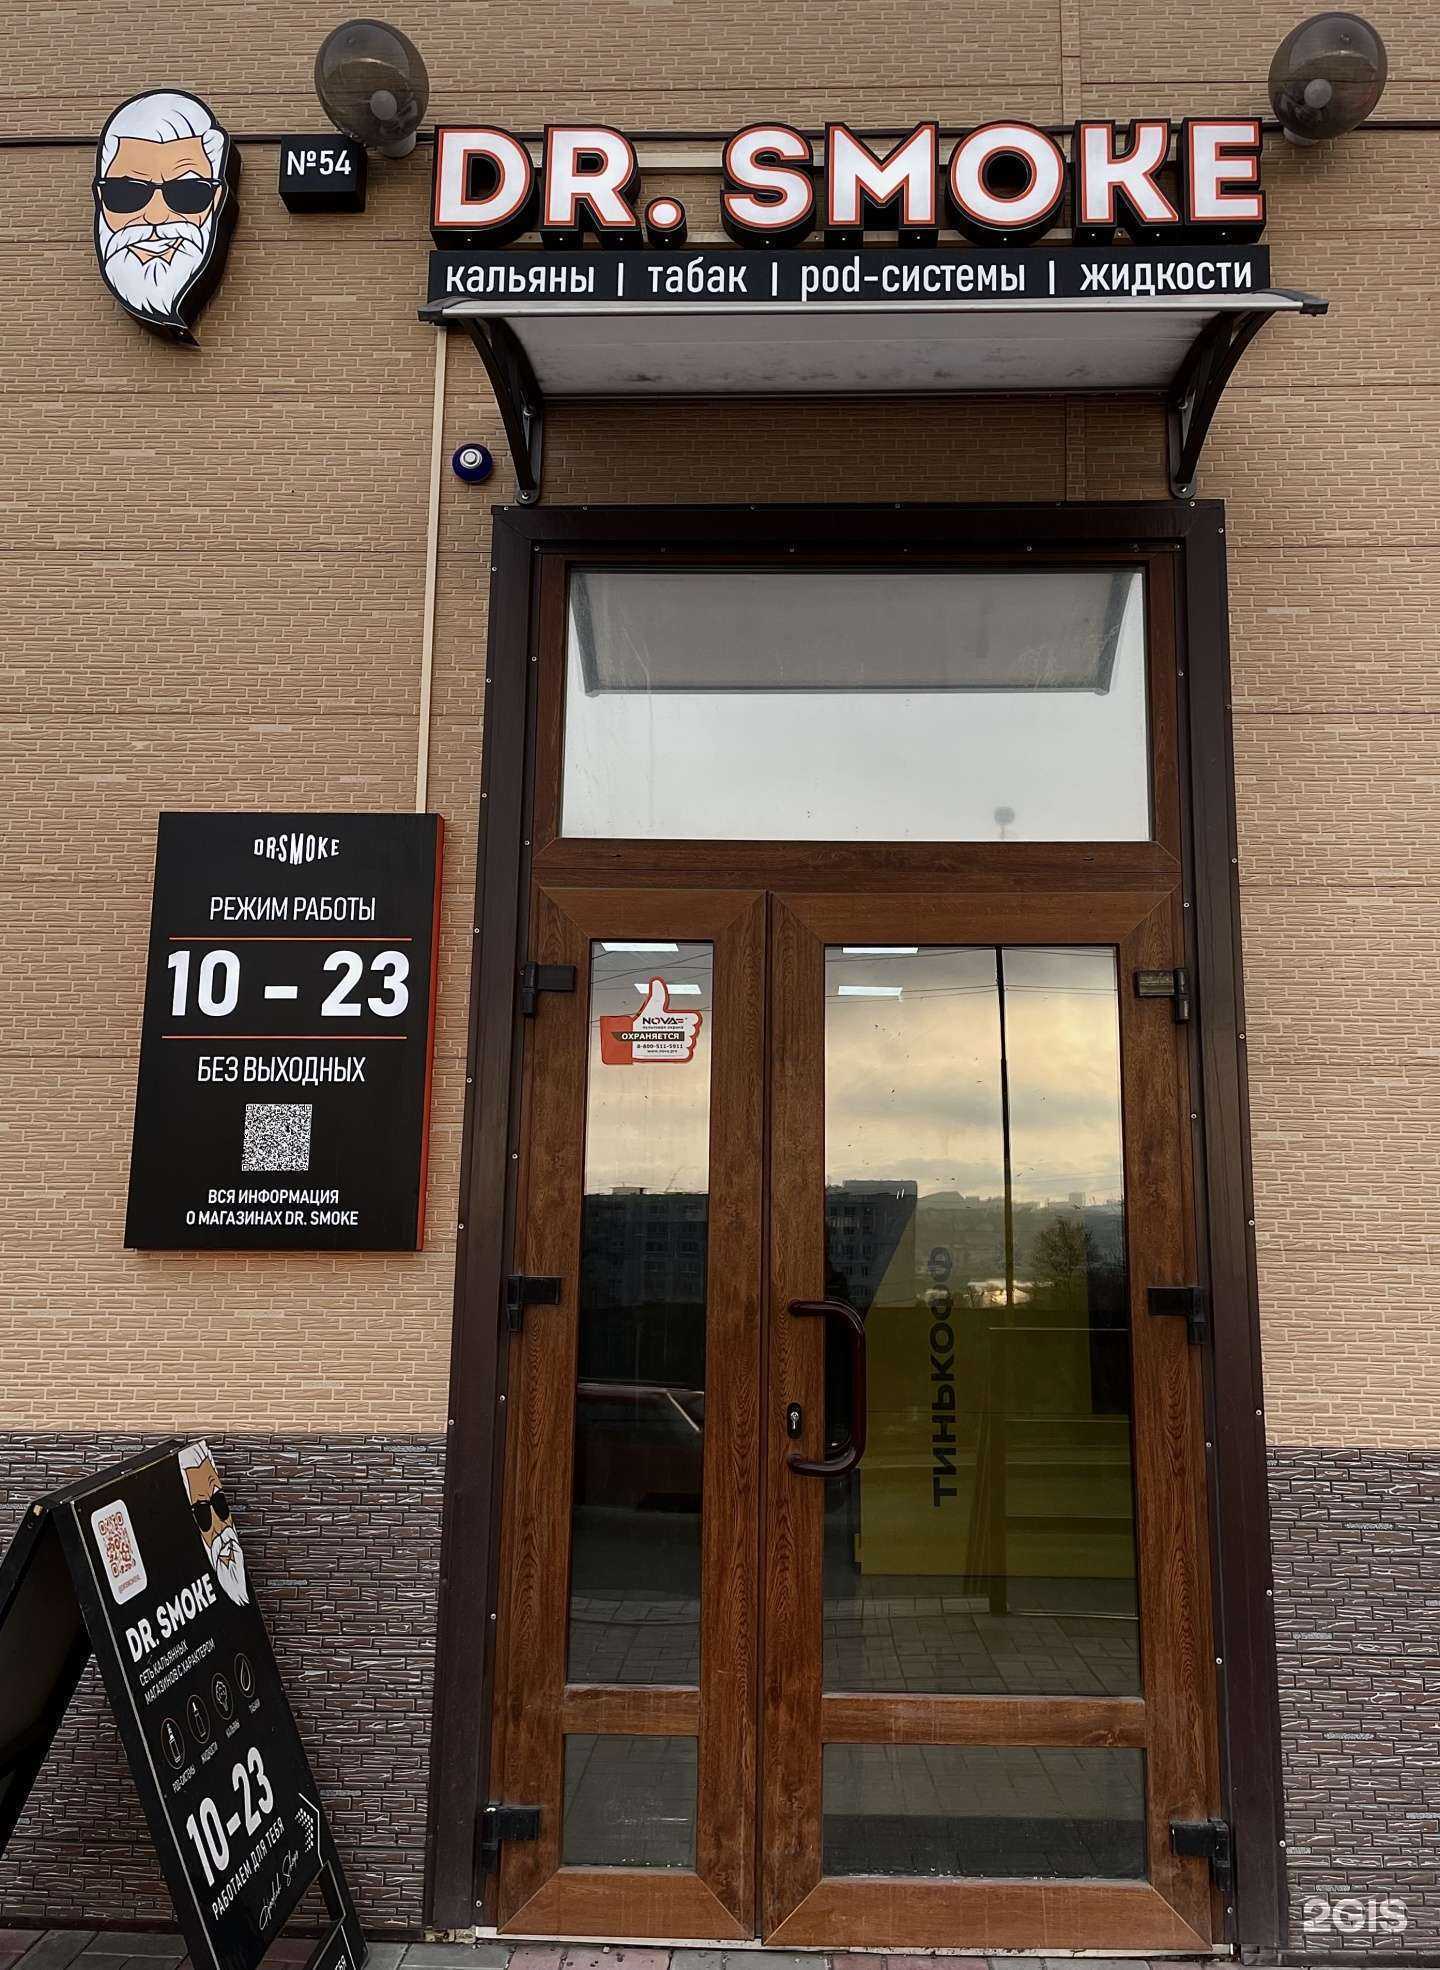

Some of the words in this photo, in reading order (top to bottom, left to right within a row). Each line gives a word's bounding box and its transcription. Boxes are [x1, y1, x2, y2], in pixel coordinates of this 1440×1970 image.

[286, 149, 352, 176] №54
[433, 125, 684, 231] DR.
[722, 118, 1264, 230] SMOKE
[445, 264, 595, 293] кальяны
[647, 256, 748, 293] табак
[801, 256, 1026, 302] pod-системы
[1080, 261, 1253, 297] жидкости
[209, 896, 289, 921] РЕЖИМ
[292, 896, 376, 921] РАБОТЫ
[167, 949, 241, 1017] 10
[320, 949, 410, 1017] 23
[621, 1032, 680, 1041] ОХРАНЯЕТСЯ
[197, 1056, 239, 1082] БЕЗ
[243, 1056, 367, 1086] ВЫХОДНЫХ
[185, 1210, 196, 1225] О
[198, 1210, 283, 1225] МАГАЗИНАХ
[284, 1210, 307, 1225] DR.
[310, 1210, 359, 1226] SMOKE
[208, 1189, 236, 1204] ВСЯ
[238, 1189, 339, 1206] ИНФОРМАЦИЯ
[125, 1626, 160, 1663] DR.
[156, 1572, 217, 1639] SMOKE
[139, 1668, 155, 1687] СЕТЬ
[153, 1639, 189, 1676] КАЛЬЯННЫХ
[144, 1668, 179, 1706] МАГАЗИНОВ
[181, 1637, 216, 1673] ХАРАКТЕРОМ
[212, 1859, 252, 1921] РАБОТАЕМ
[250, 1839, 268, 1873] ДЛЯ
[264, 1817, 285, 1848] ТЕБЯ
